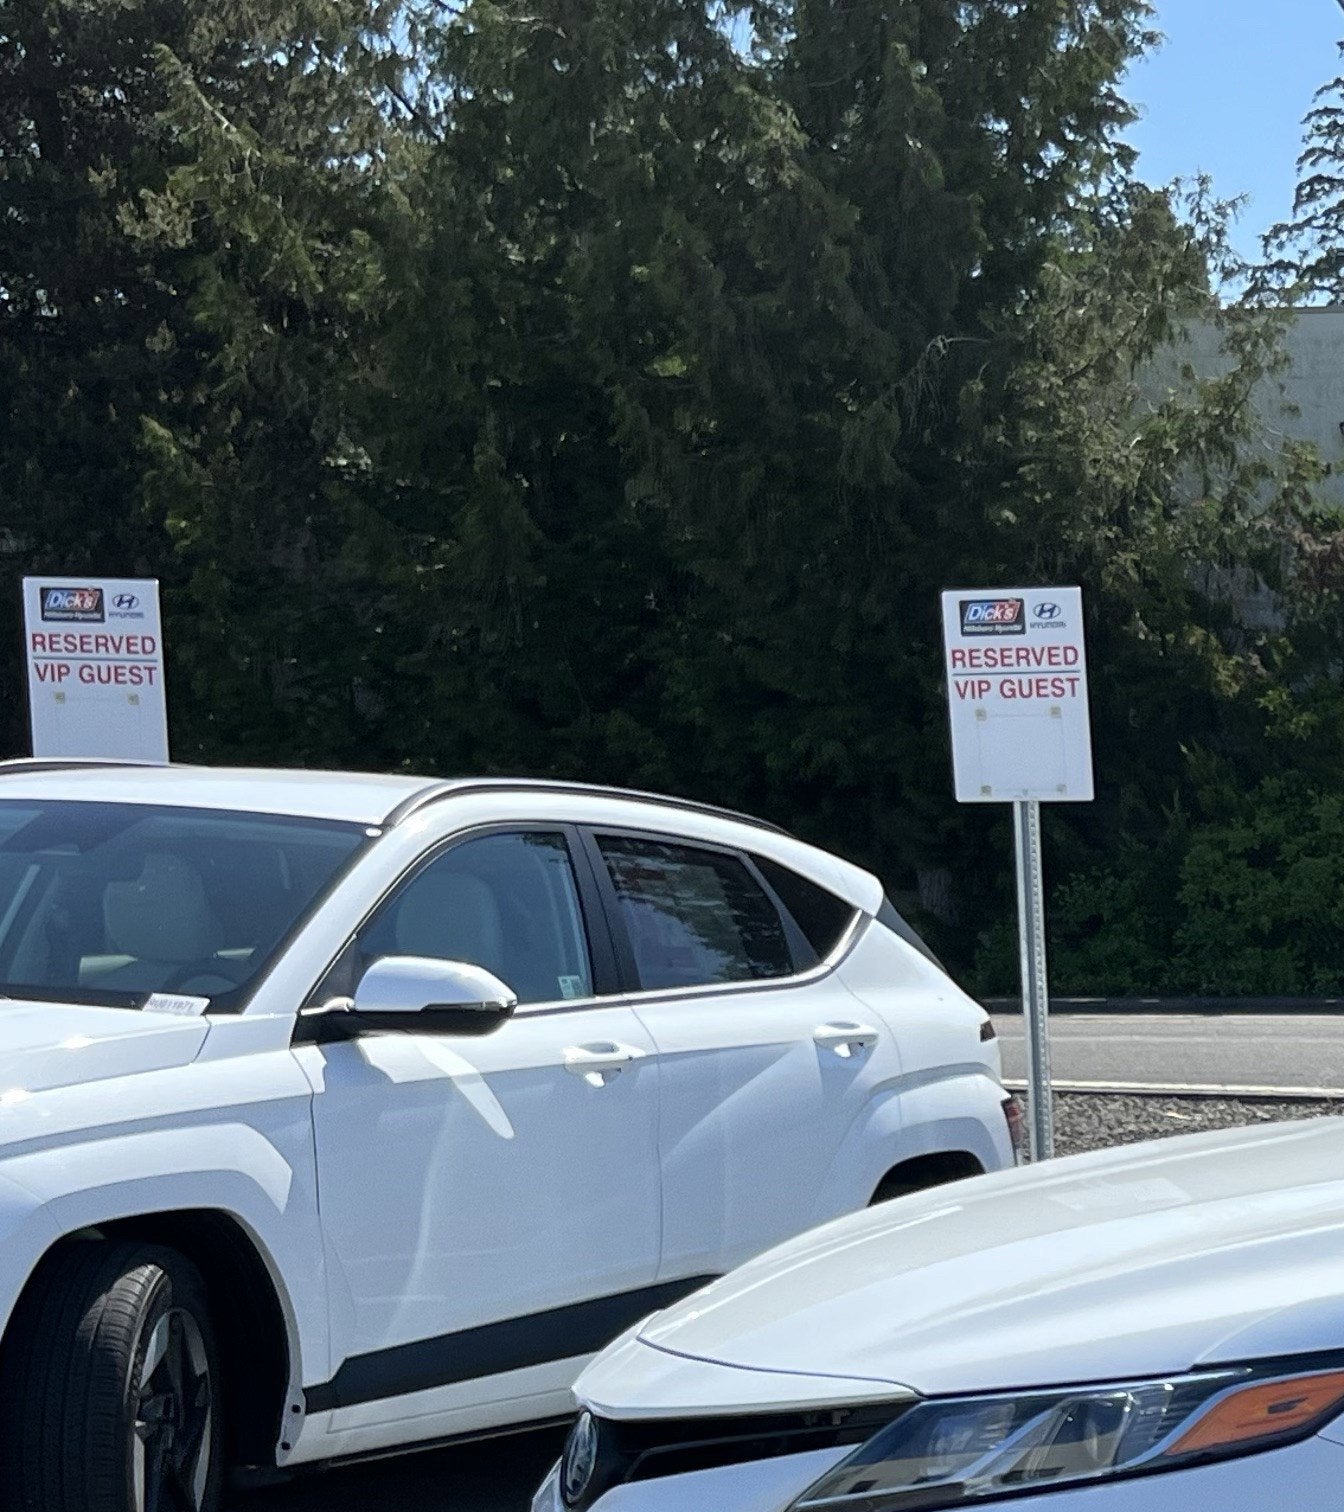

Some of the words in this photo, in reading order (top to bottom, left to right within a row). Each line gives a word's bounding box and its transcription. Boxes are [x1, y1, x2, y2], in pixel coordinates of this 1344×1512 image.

[31, 632, 156, 655] RESERVED
[951, 645, 1080, 669] RESERVED
[34, 662, 71, 683] VIP
[78, 664, 157, 686] GUEST
[954, 679, 991, 700] VIP
[999, 677, 1081, 699] GUEST
